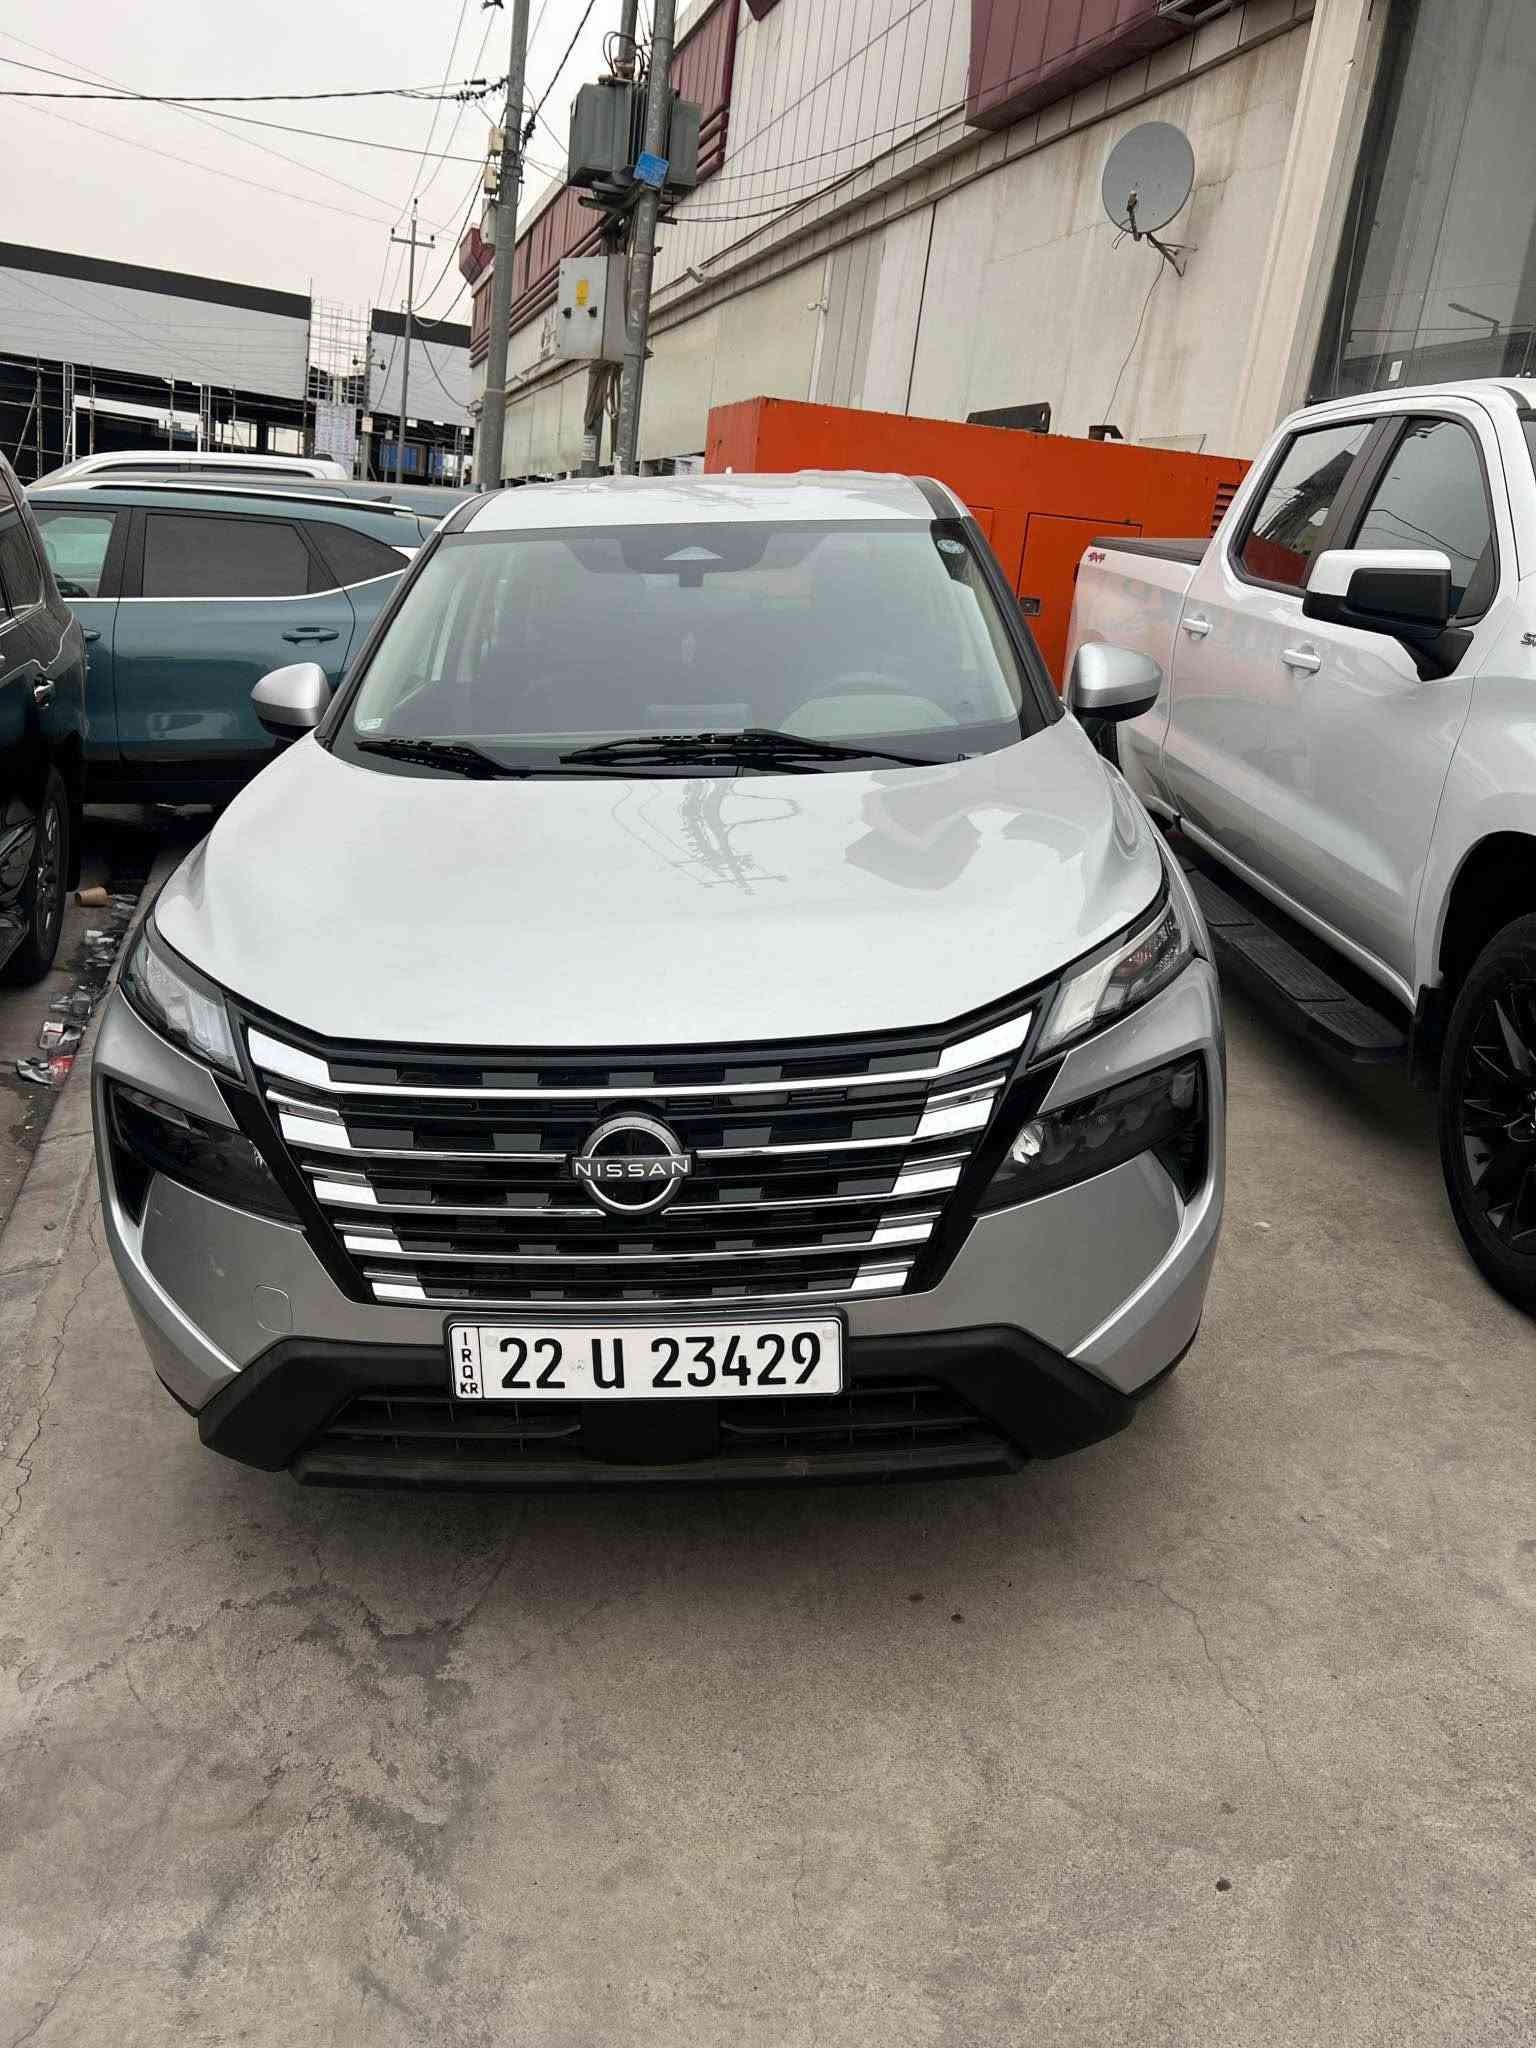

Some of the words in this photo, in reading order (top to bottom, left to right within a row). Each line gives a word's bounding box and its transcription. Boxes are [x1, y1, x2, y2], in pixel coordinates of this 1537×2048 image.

[575, 1159, 689, 1177] NISSAN
[461, 1331, 474, 1380] IRQ
[499, 1337, 566, 1389] 22
[650, 1331, 821, 1388] 23429
[459, 1382, 479, 1394] KR
